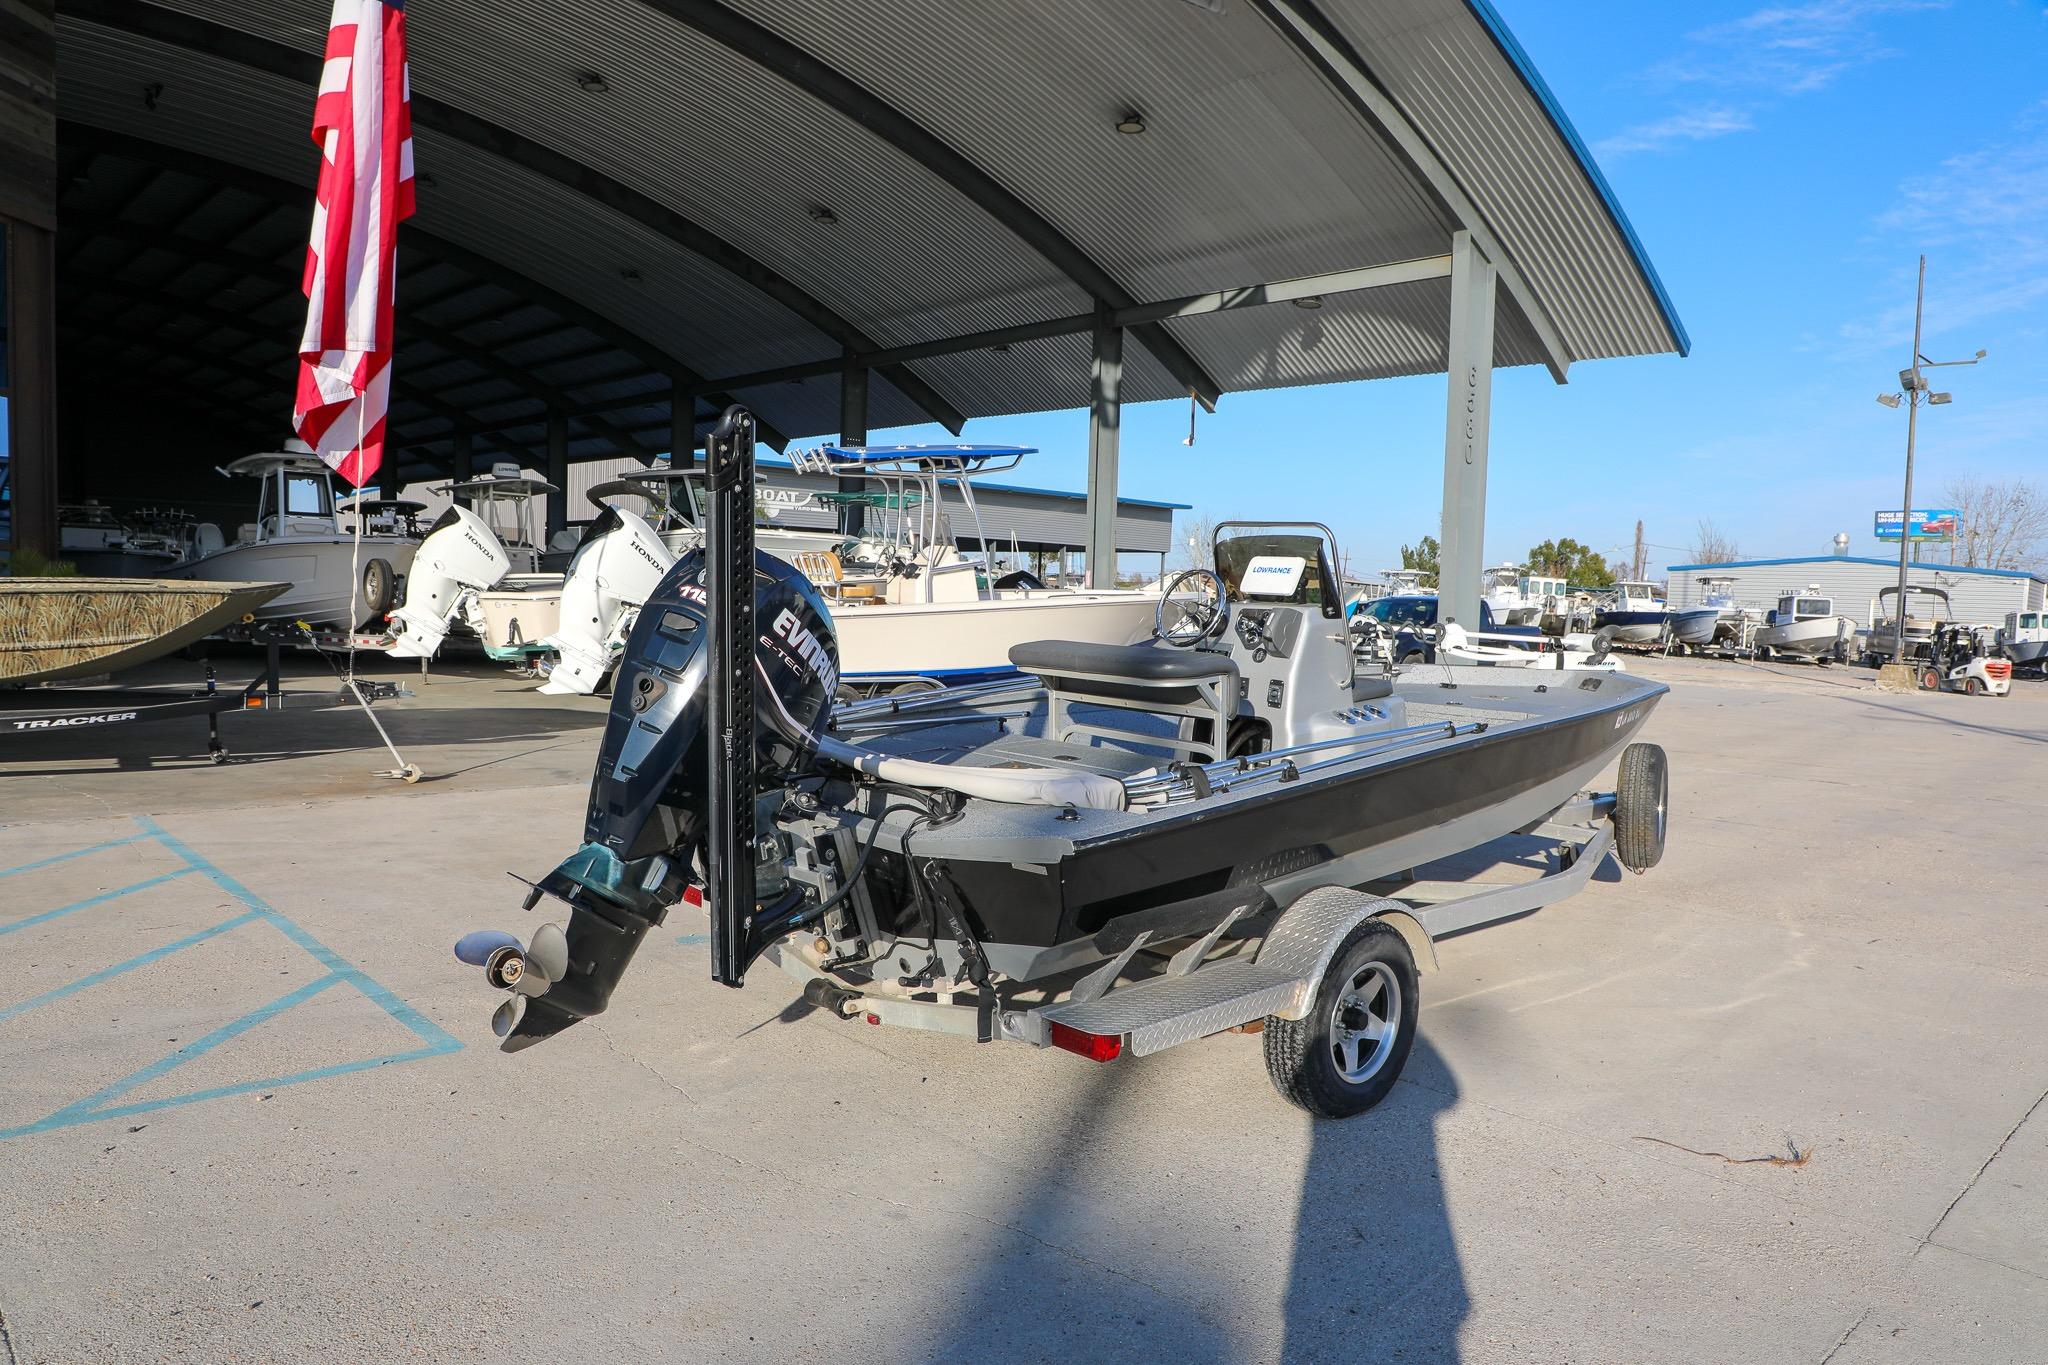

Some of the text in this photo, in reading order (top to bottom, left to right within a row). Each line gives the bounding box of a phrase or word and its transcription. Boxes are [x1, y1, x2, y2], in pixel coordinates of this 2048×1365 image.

[754, 488, 800, 503] BOAT
[464, 532, 495, 562] HONDA
[629, 540, 665, 576] HONDA
[1253, 566, 1293, 574] LOWRANCE
[759, 635, 804, 678] E-TEC
[13, 712, 137, 730] TRACKER
